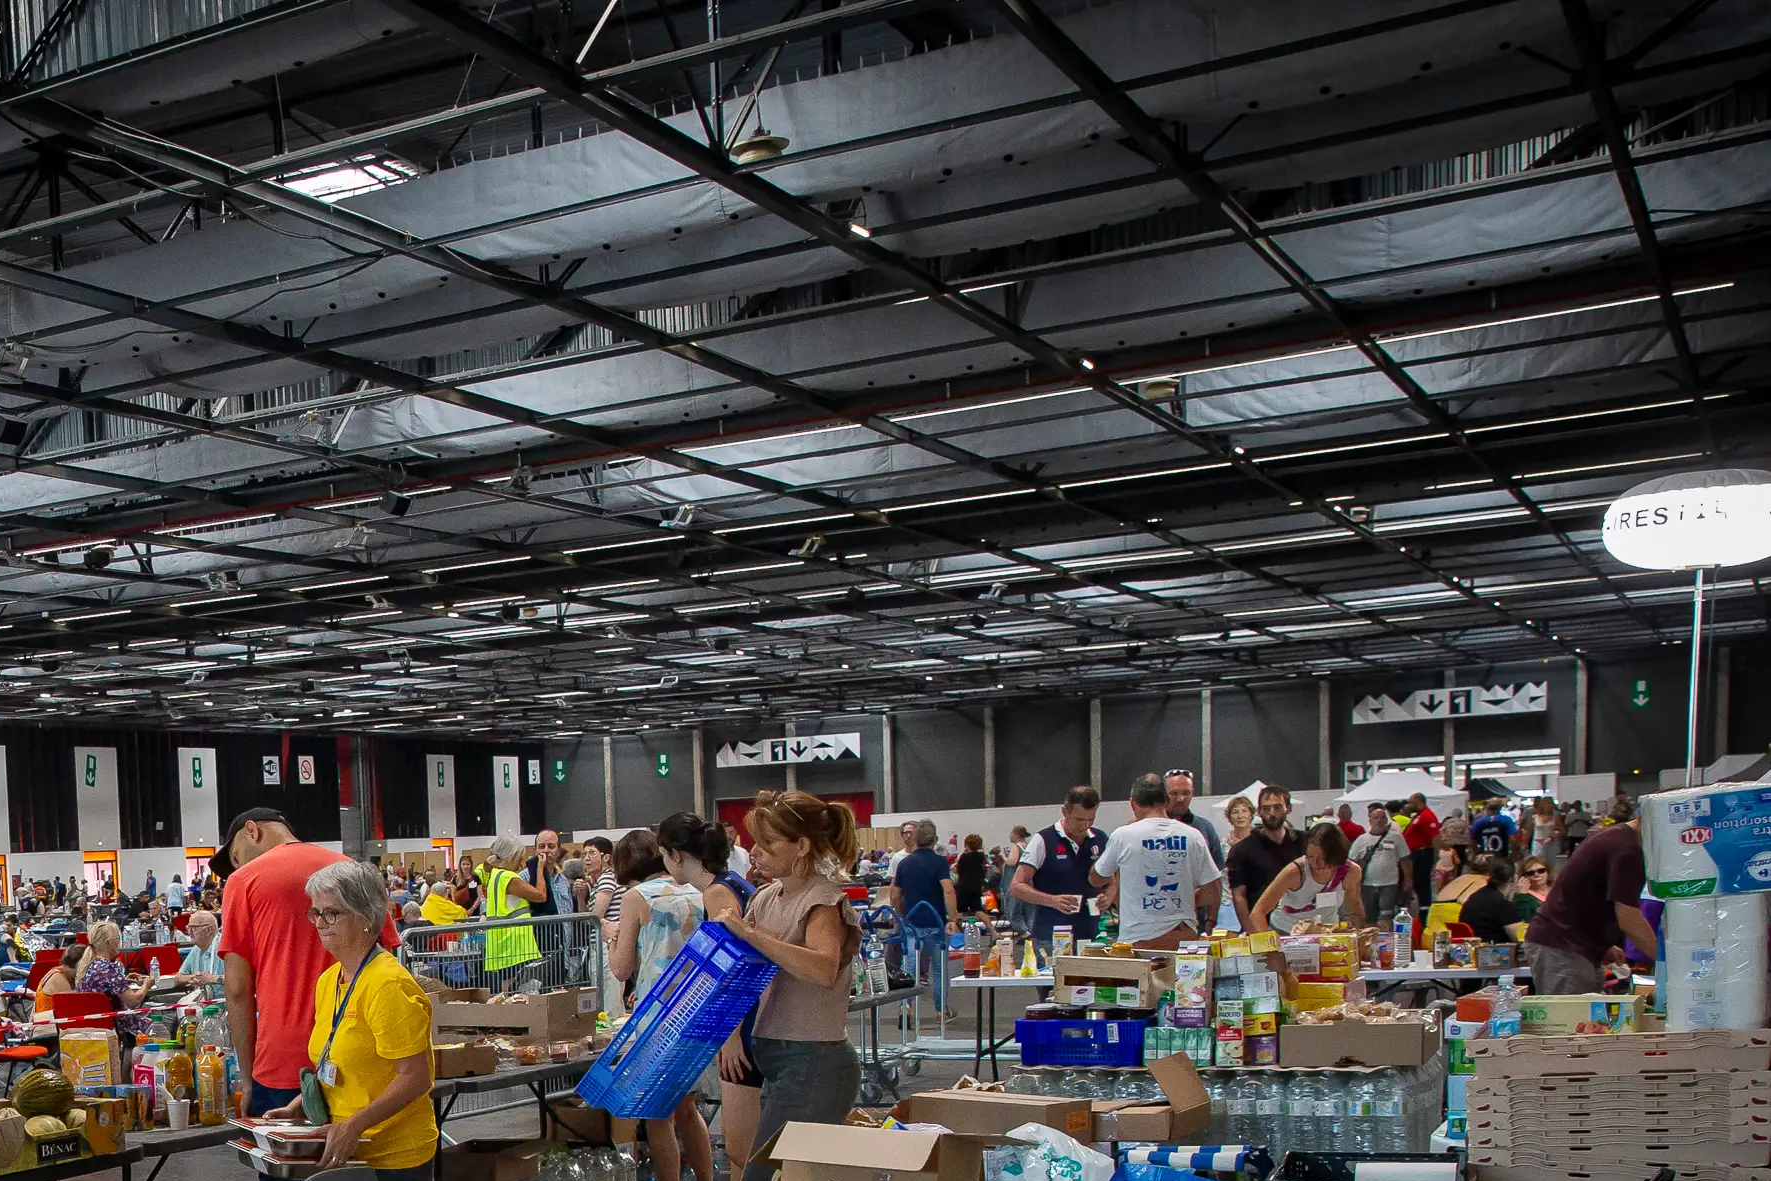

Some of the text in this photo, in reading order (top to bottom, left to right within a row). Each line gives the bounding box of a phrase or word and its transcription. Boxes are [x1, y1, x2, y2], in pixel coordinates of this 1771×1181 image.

[1453, 695, 1467, 714] 1
[774, 745, 783, 761] 1
[531, 769, 537, 782] 5
[1482, 835, 1503, 852] 10
[1680, 828, 1710, 843] XXL
[41, 1141, 77, 1158] BÉNAC
